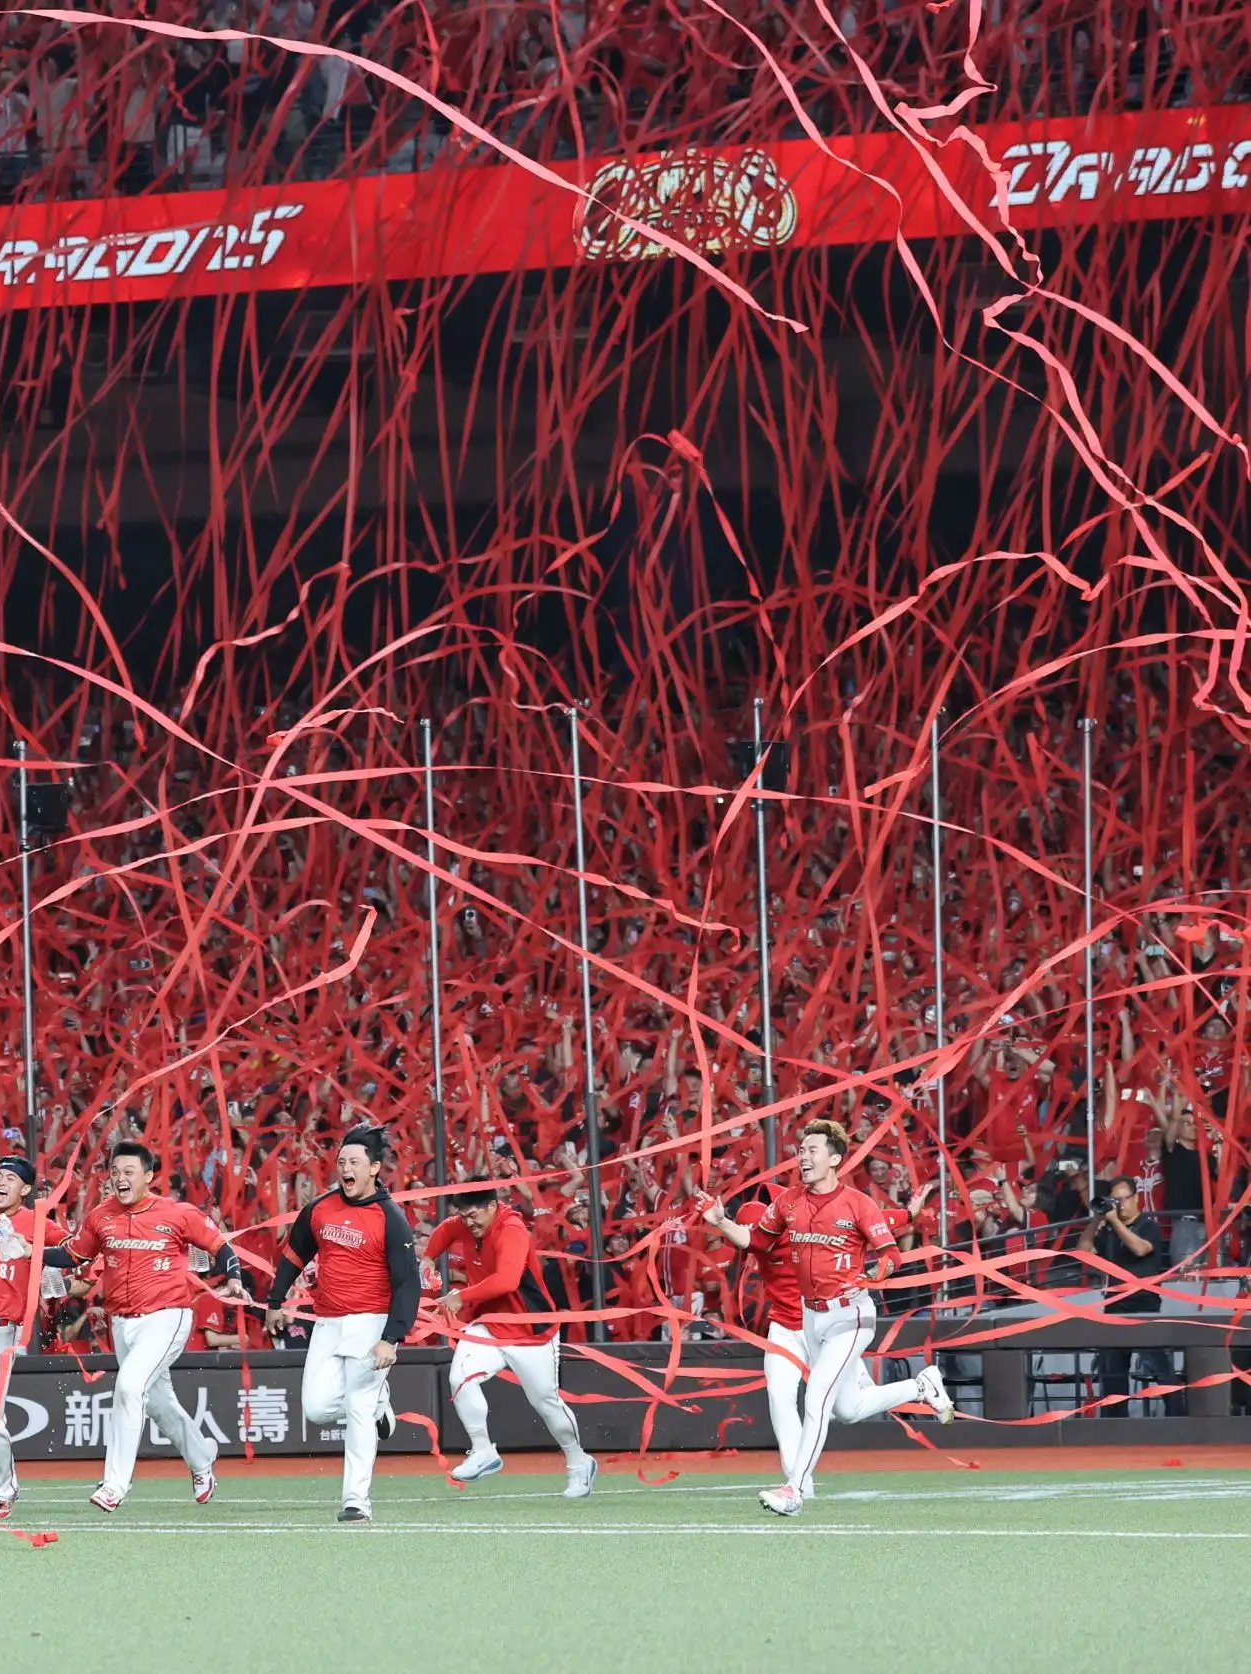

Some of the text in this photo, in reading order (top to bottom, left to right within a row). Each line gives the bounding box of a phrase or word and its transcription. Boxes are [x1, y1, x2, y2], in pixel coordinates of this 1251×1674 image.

[105, 1236, 169, 1251] DRAGONS
[789, 1230, 847, 1246] DRAGONS
[834, 1253, 852, 1271] 71
